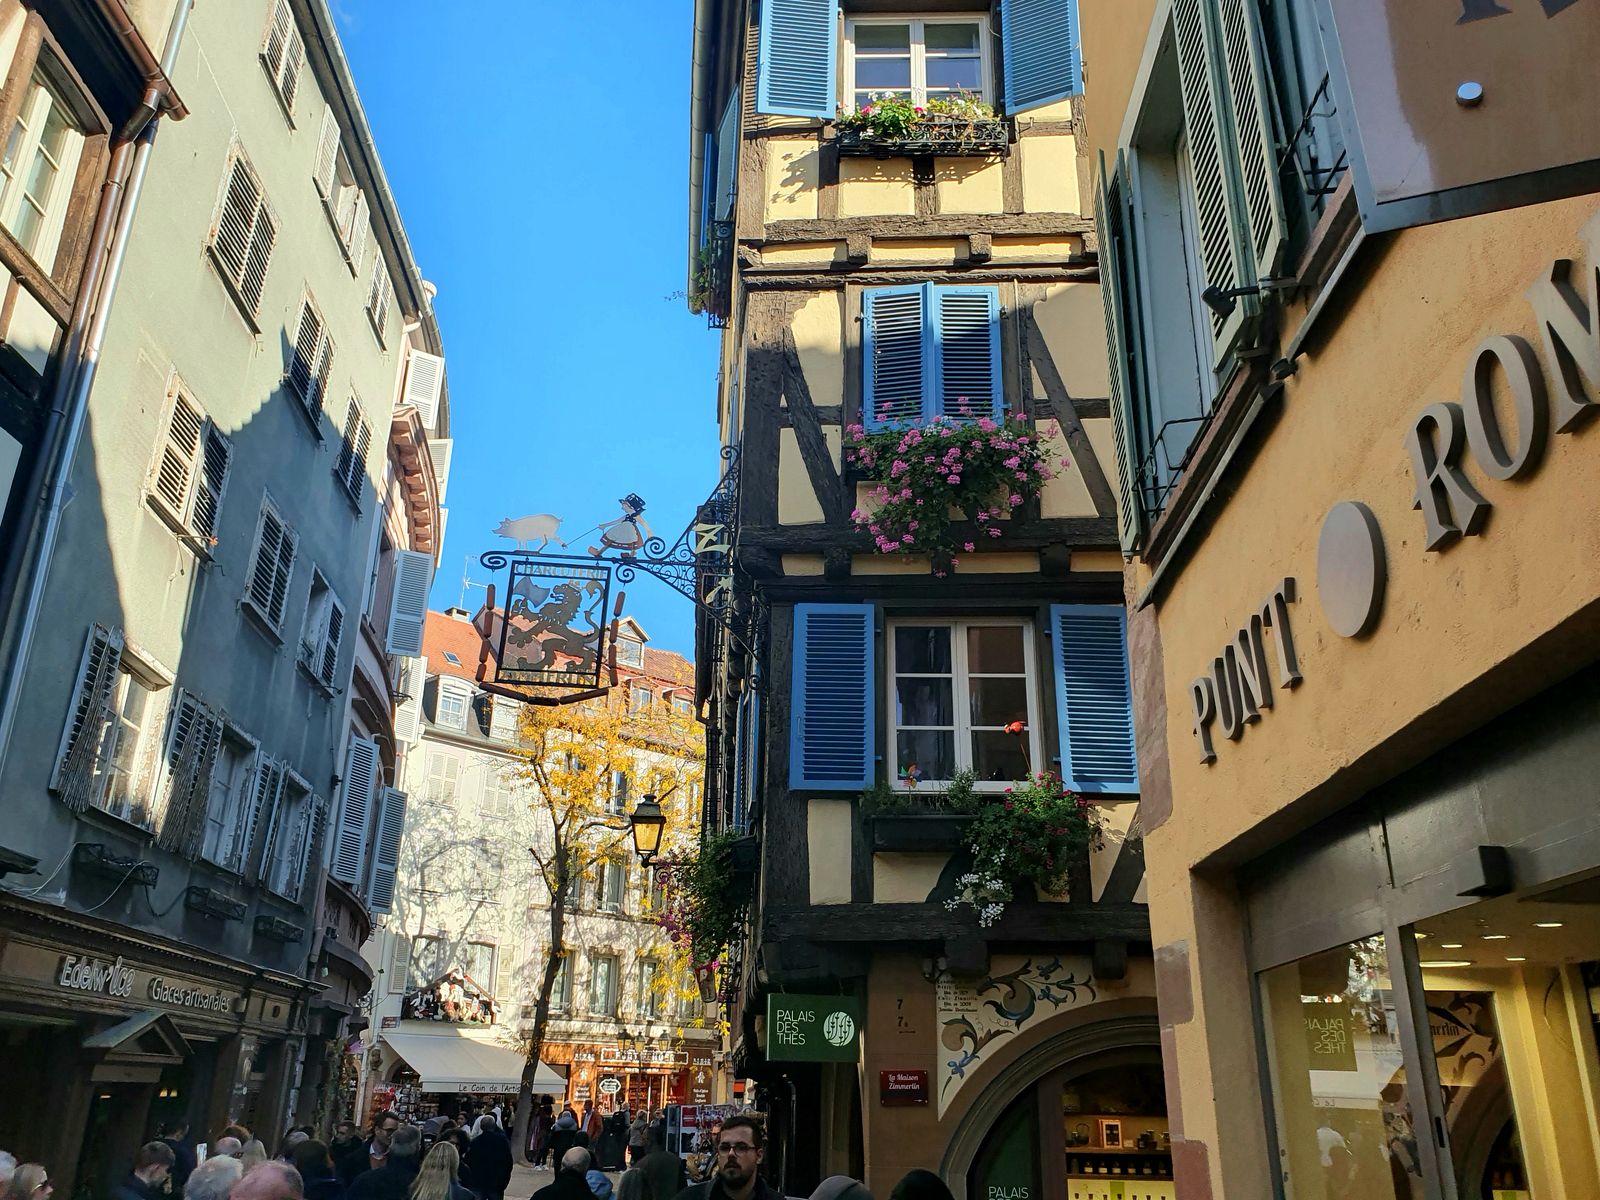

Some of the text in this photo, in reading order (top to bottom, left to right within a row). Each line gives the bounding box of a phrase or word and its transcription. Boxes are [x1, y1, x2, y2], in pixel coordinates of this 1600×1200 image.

[515, 563, 608, 580] CHARCUTERIE
[1188, 576, 1304, 765] PUNT
[151, 977, 184, 1004] Glaces
[184, 987, 230, 1012] artisanales
[896, 998, 904, 1010] 7
[776, 1009, 816, 1023] PALAIS
[776, 1021, 799, 1033] DES
[888, 1073, 919, 1083] La Maison
[458, 1083, 522, 1093] Le Coin de l'Artis
[888, 1082, 920, 1090] Zimmerlin
[988, 1186, 1029, 1199] PALAIS
